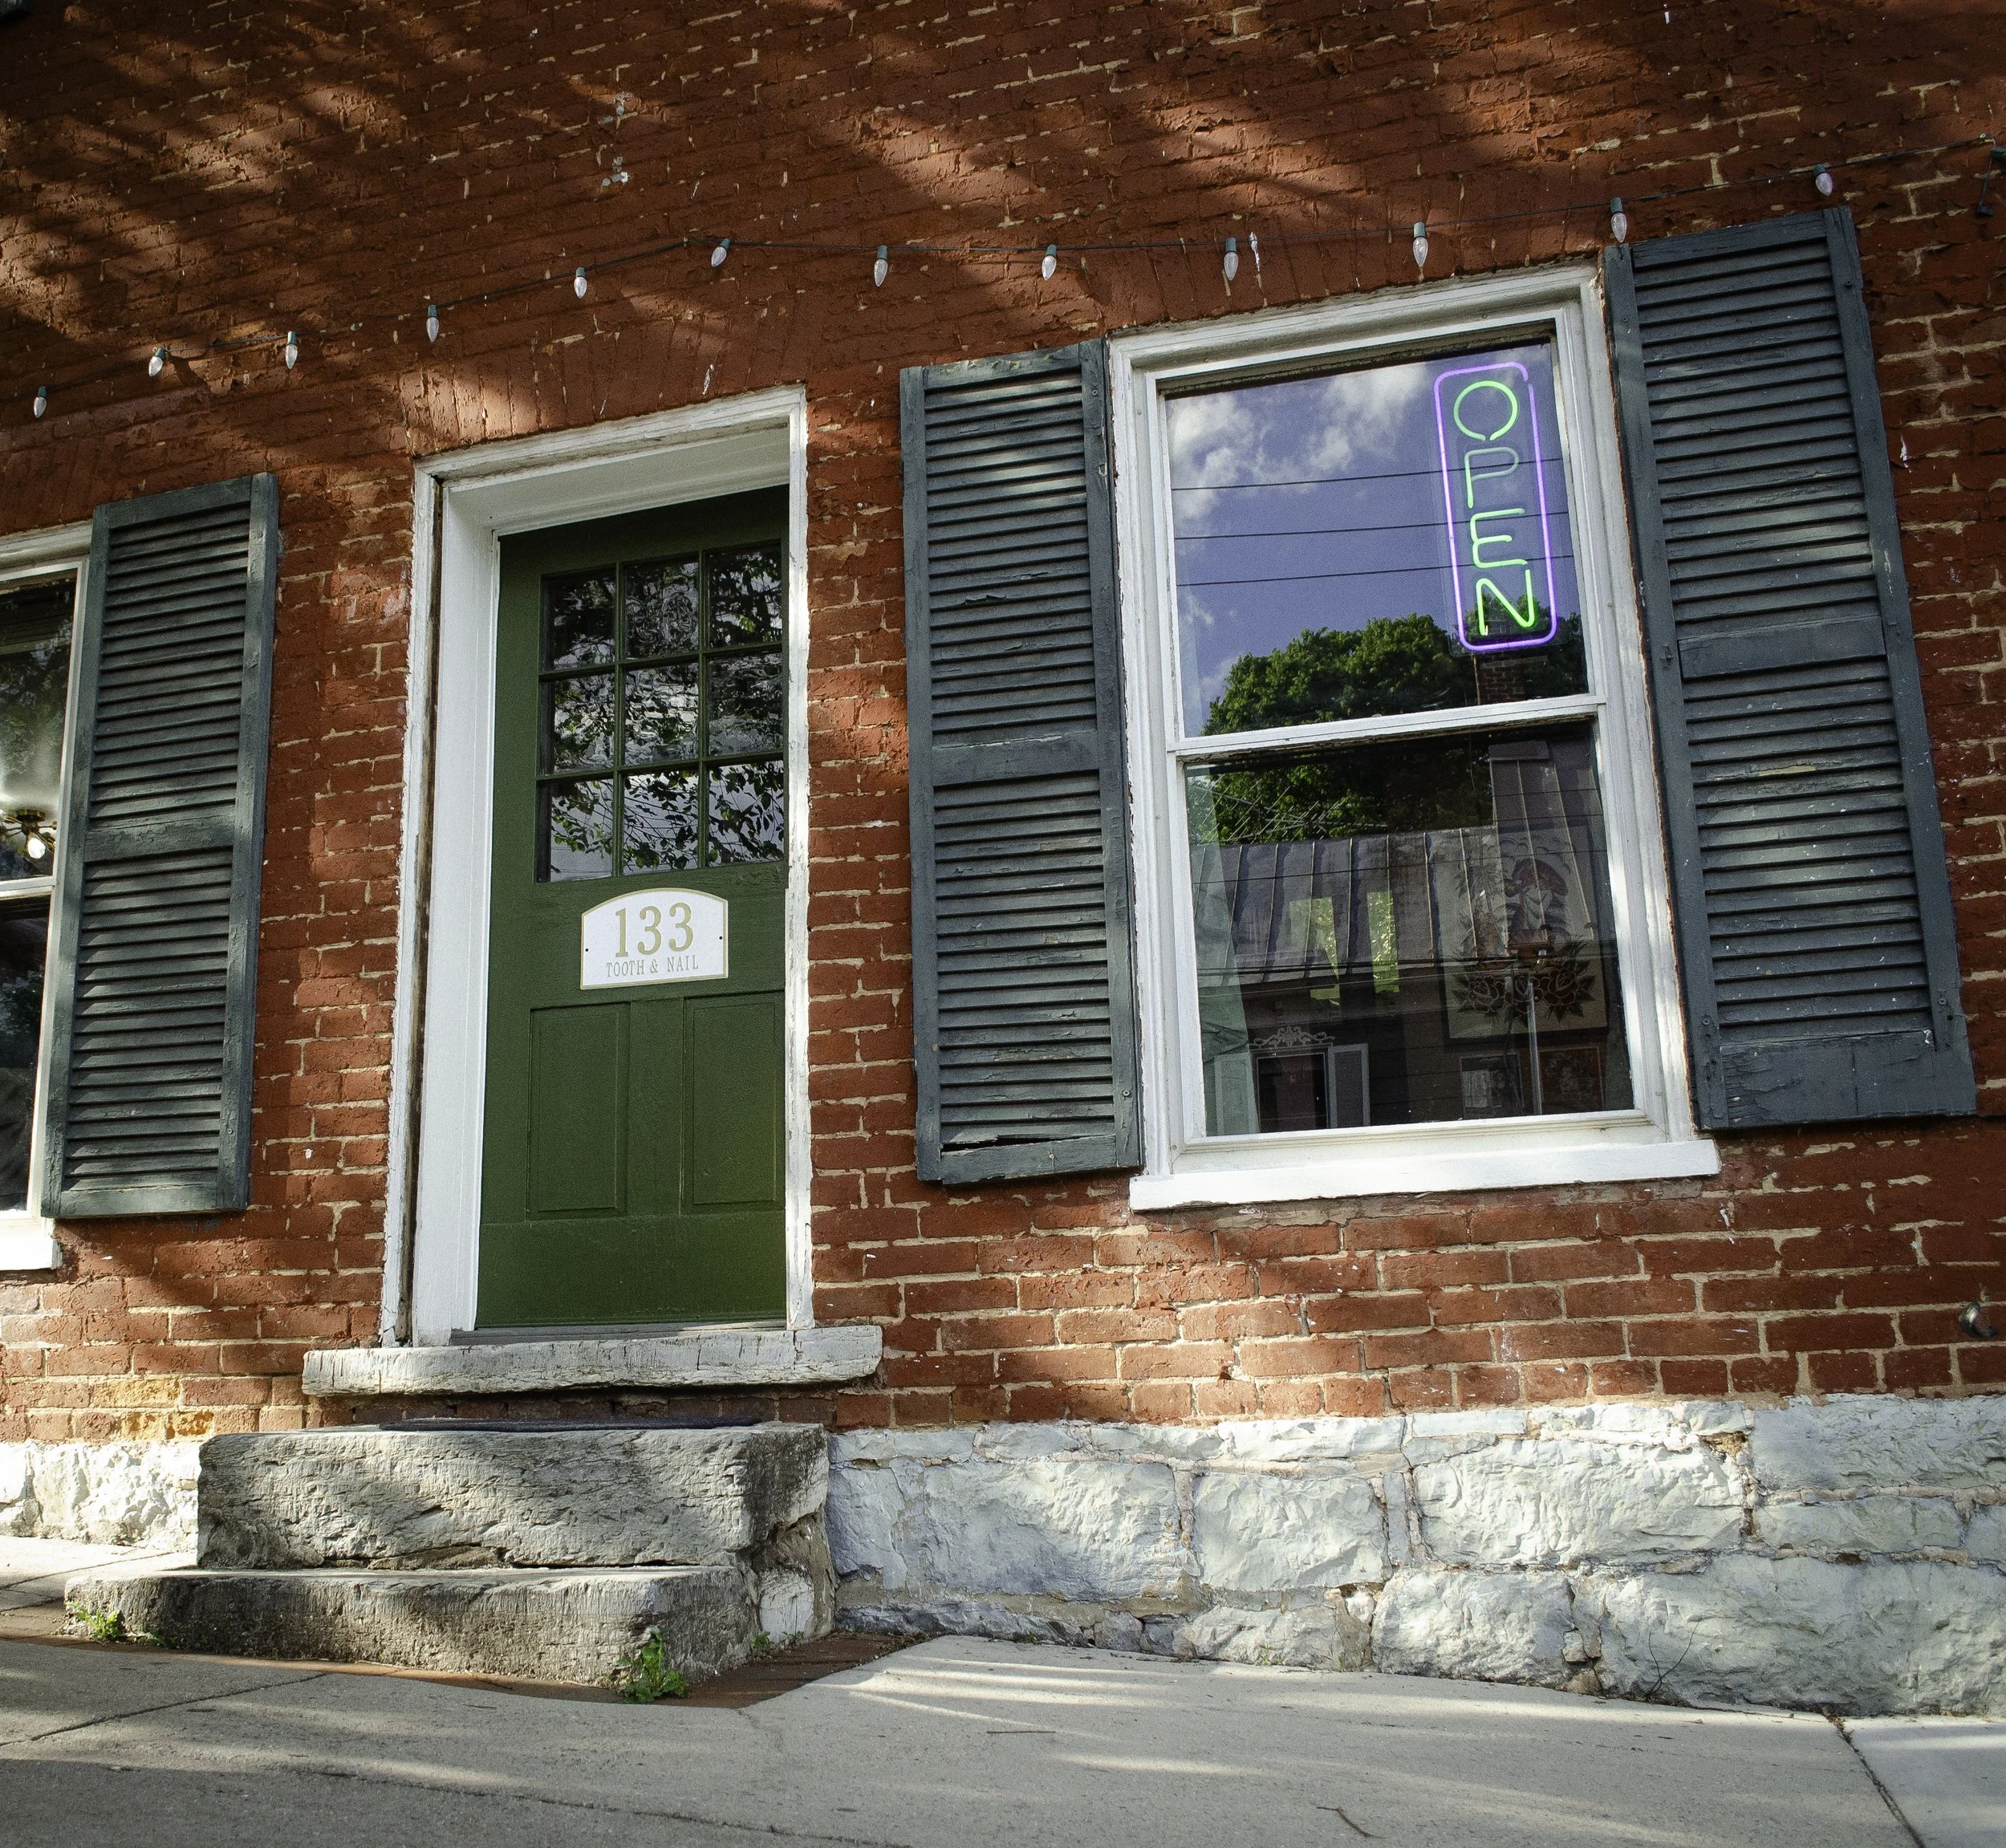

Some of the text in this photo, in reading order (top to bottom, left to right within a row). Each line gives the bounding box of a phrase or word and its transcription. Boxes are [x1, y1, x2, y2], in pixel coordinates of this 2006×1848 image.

[1453, 380, 1536, 636] OPEN
[615, 903, 693, 957] 133
[606, 955, 699, 977] TOOTH & NAIL
